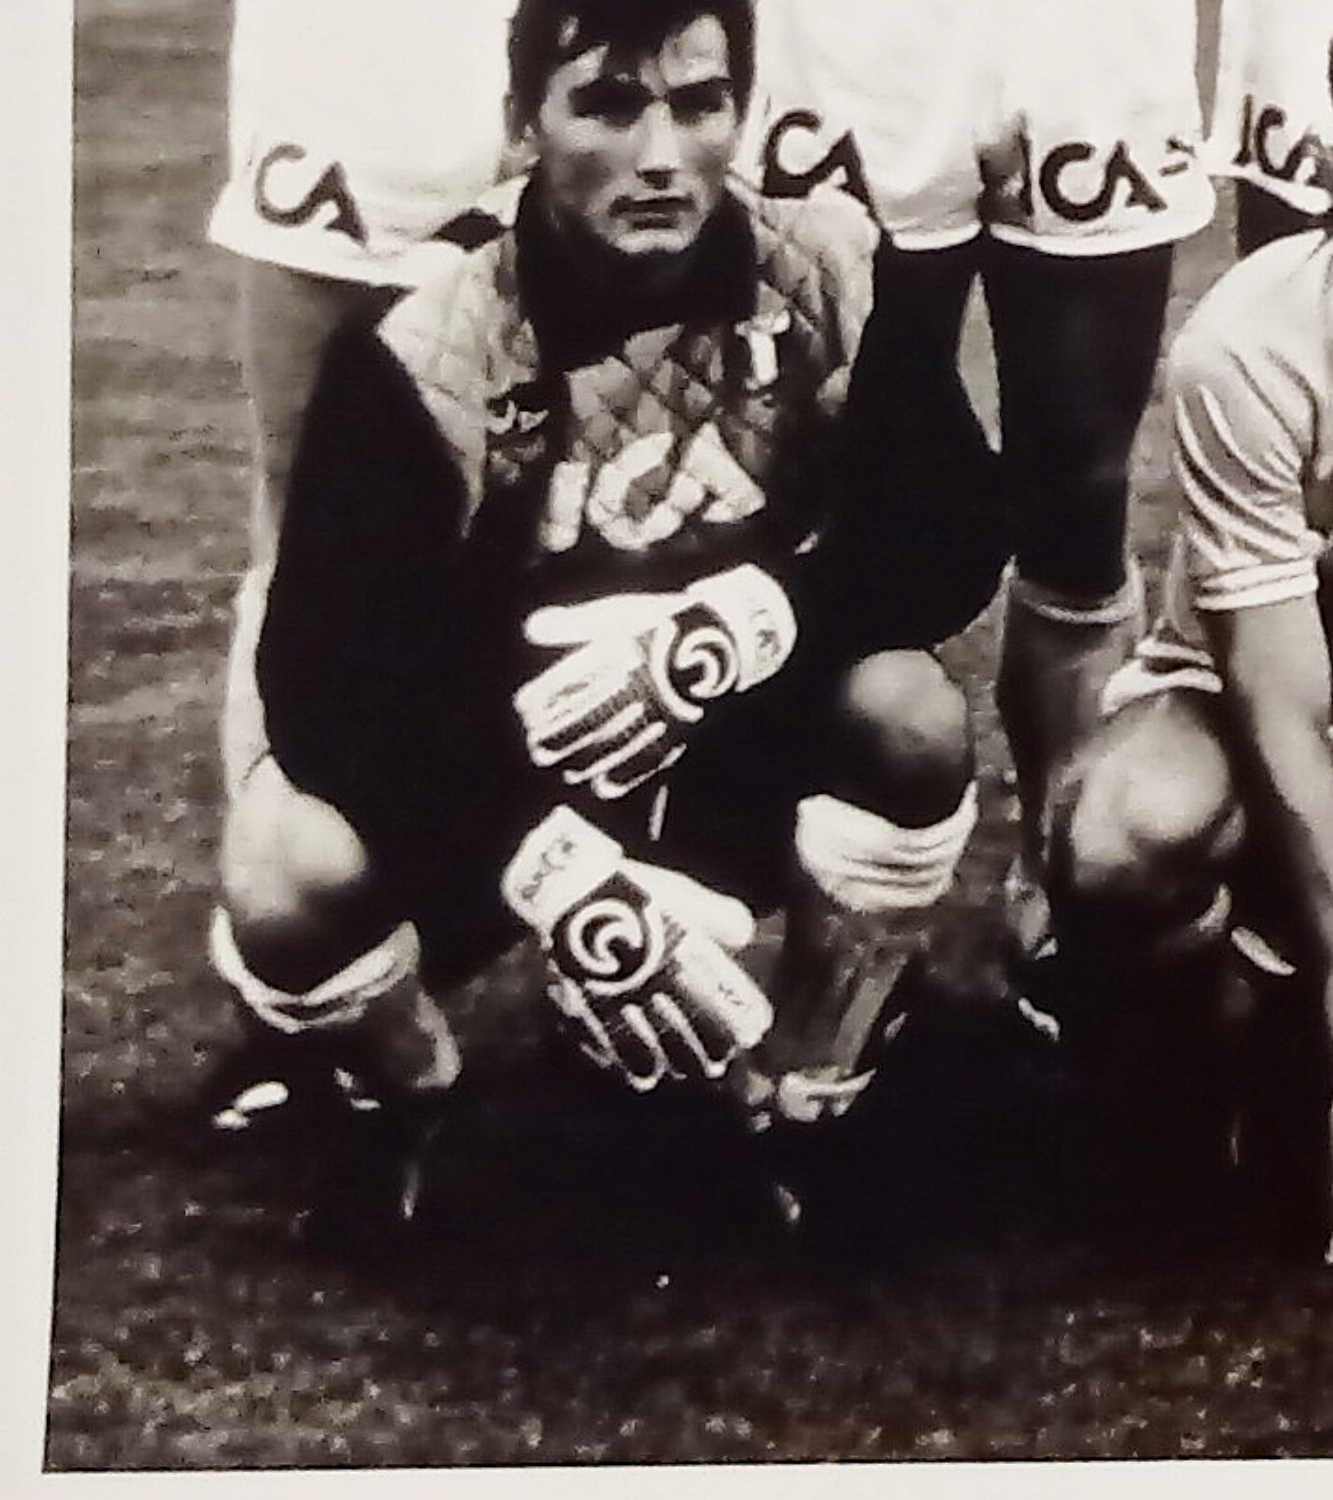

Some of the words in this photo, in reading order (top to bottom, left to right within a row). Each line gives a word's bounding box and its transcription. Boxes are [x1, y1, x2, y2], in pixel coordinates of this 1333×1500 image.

[254, 141, 369, 249] CA
[762, 107, 878, 206] CA
[1018, 136, 1168, 222] ICA
[541, 421, 766, 553] ICA
